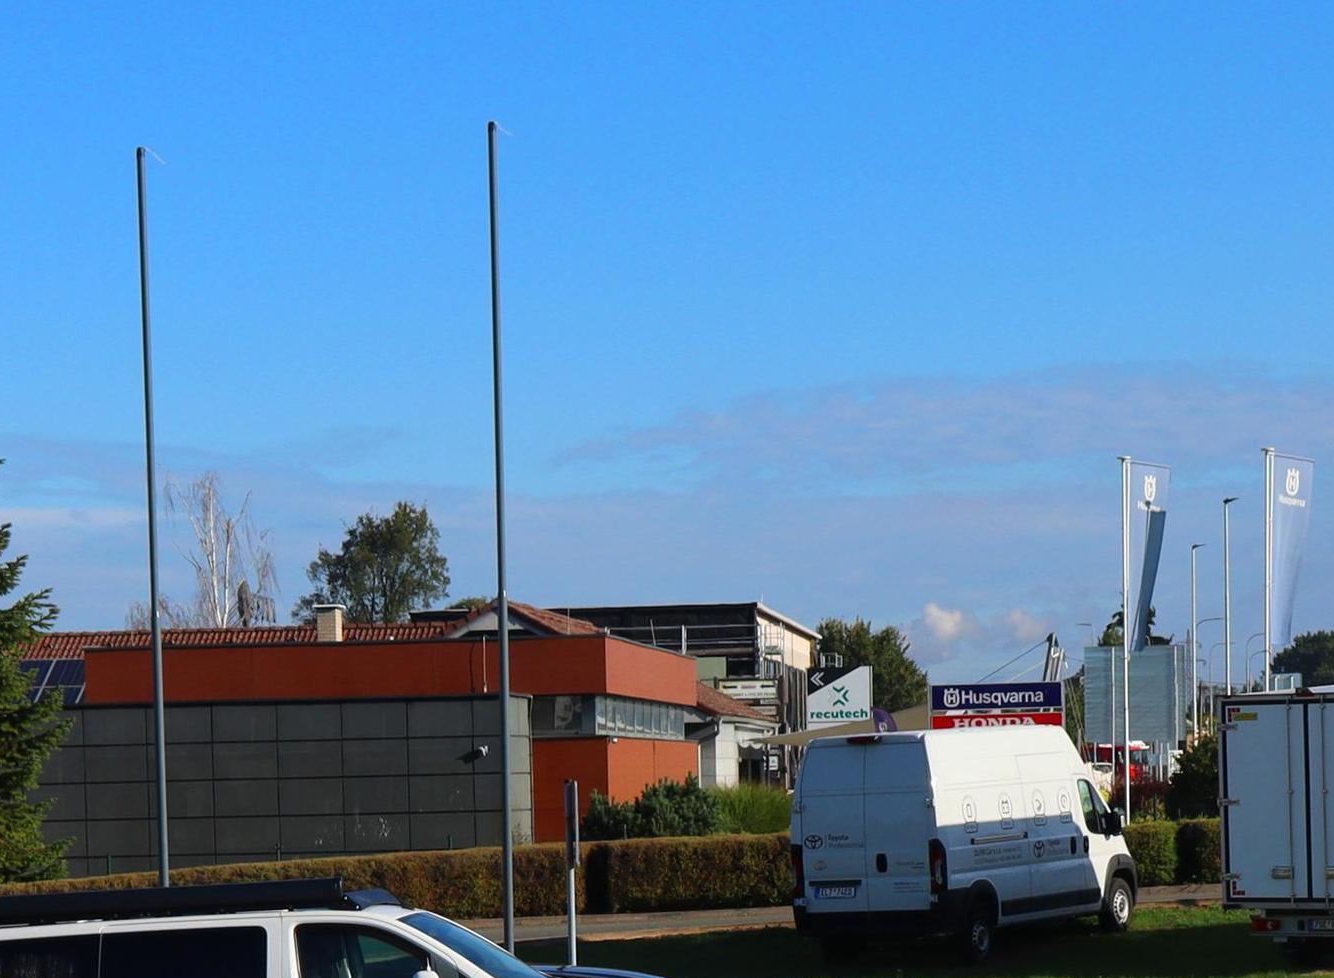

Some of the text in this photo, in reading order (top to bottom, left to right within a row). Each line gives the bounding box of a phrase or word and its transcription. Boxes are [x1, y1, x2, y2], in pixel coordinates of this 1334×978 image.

[961, 689, 1044, 706] Husqvarna
[810, 708, 868, 719] recutech
[953, 716, 1036, 729] HONDA
